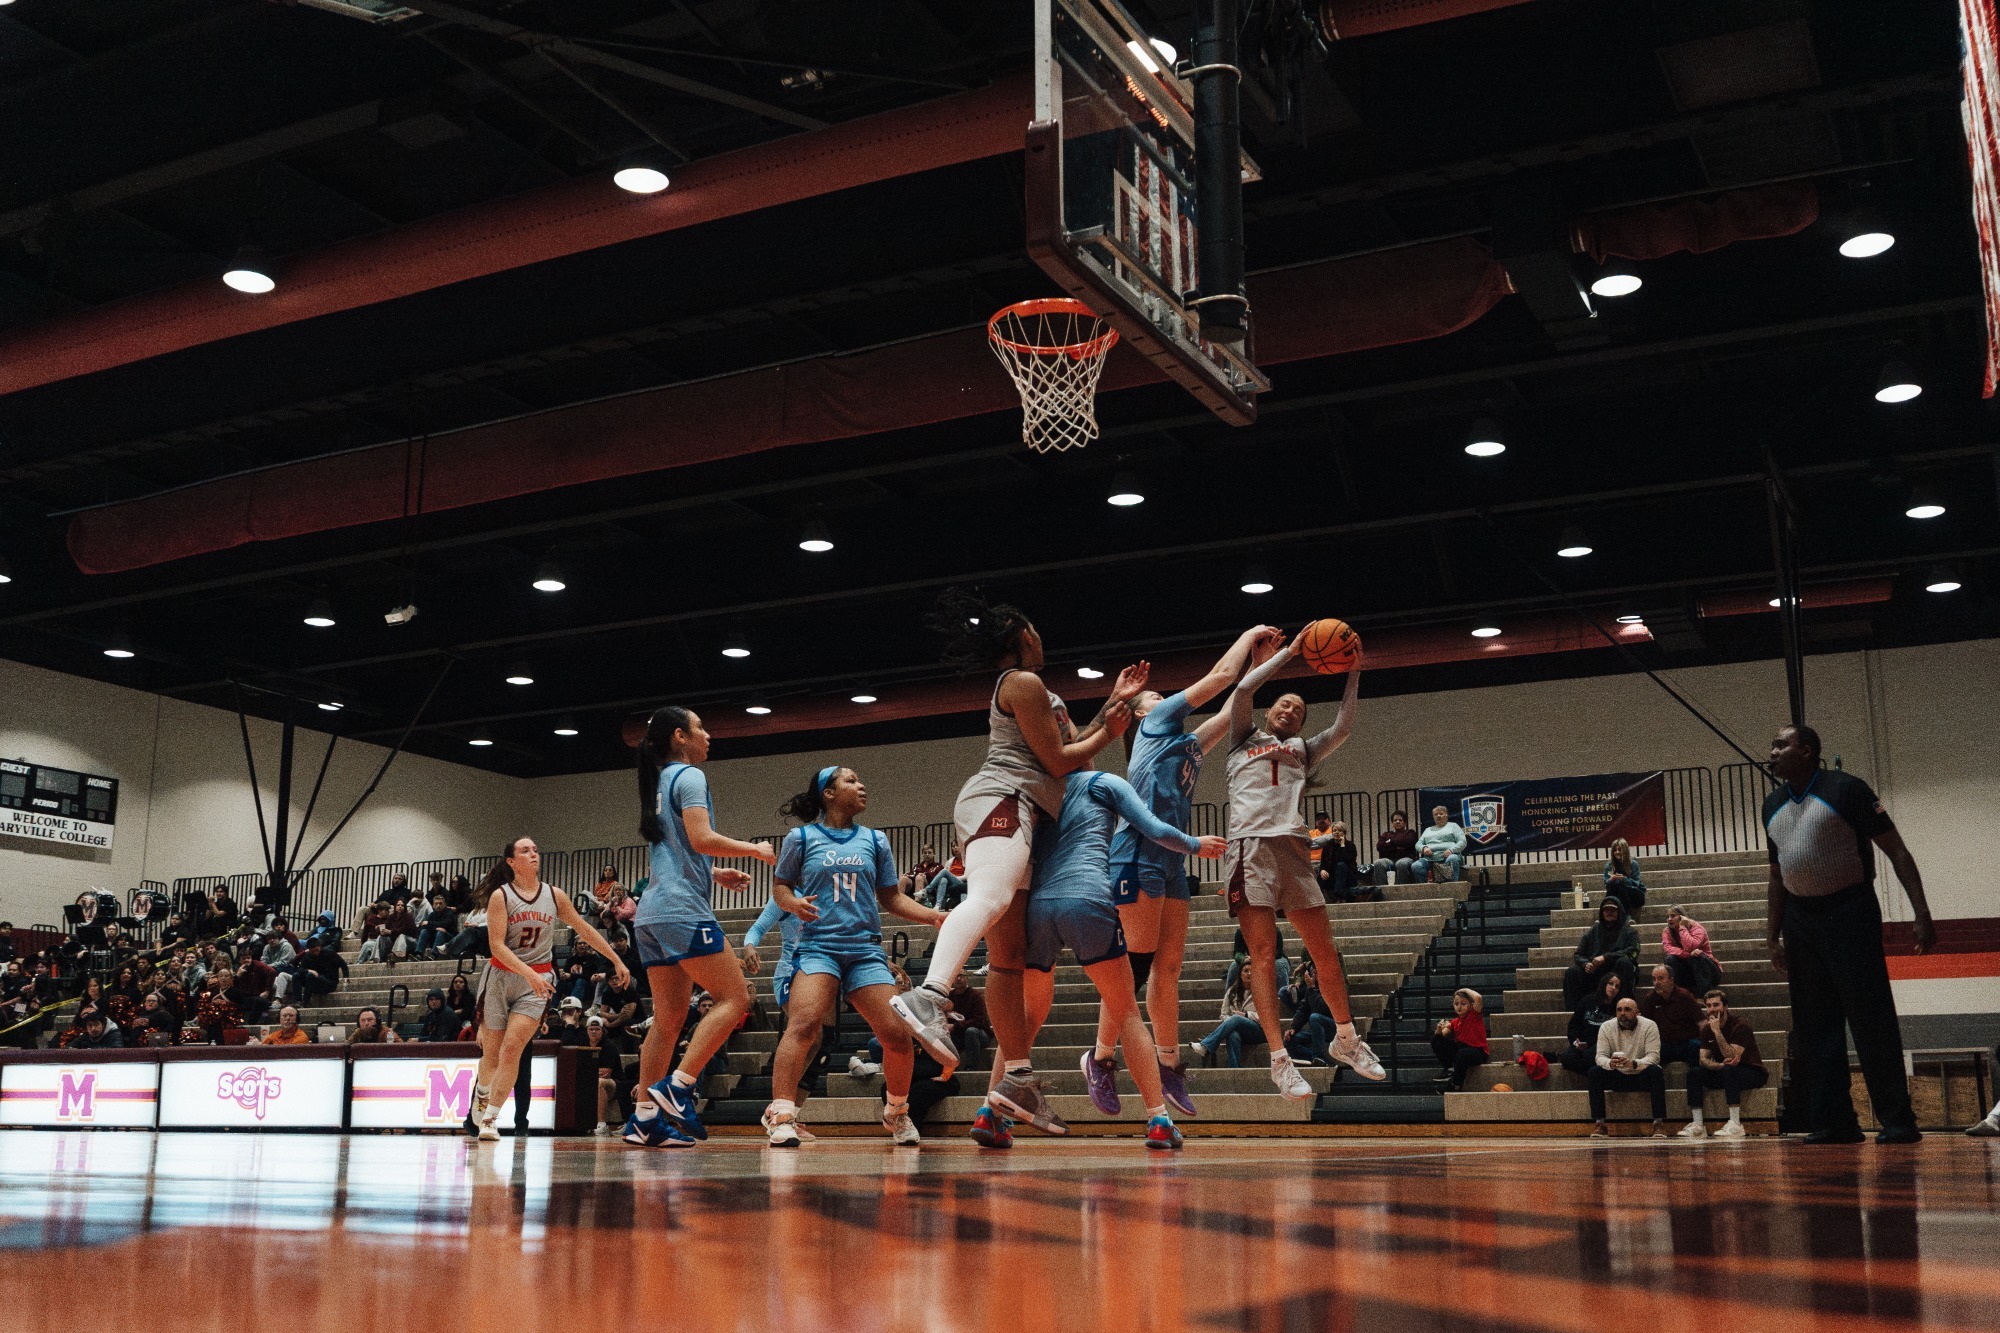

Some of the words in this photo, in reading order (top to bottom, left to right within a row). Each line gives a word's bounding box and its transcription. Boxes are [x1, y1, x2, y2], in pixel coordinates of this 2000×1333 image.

[0, 762, 31, 774] GUEST
[87, 778, 112, 789] HOME
[32, 798, 59, 809] PERIOD
[1525, 795, 1578, 805] CELEBRATING
[1597, 792, 1618, 800] PAST.
[1471, 806, 1496, 825] 50
[1521, 807, 1567, 816] HONORING
[1570, 805, 1584, 813] THE
[1586, 803, 1621, 812] PRESENT.
[13, 812, 69, 829] WELCOME
[73, 821, 87, 832] TO
[992, 818, 1007, 828] M
[1531, 817, 1570, 827] LOOKING
[1572, 814, 1613, 824] FORWARD
[1572, 824, 1603, 833] FUTURE.
[60, 831, 107, 846] COLLEGE
[823, 850, 865, 867] Scots
[832, 872, 857, 903] 14
[1120, 880, 1129, 895] C
[135, 898, 151, 915] M
[508, 911, 553, 925] MARYVILLE
[519, 926, 541, 948] 21
[702, 927, 713, 944] C
[58, 1072, 96, 1118] M
[217, 1067, 281, 1117] Scots
[425, 1068, 475, 1119] M
